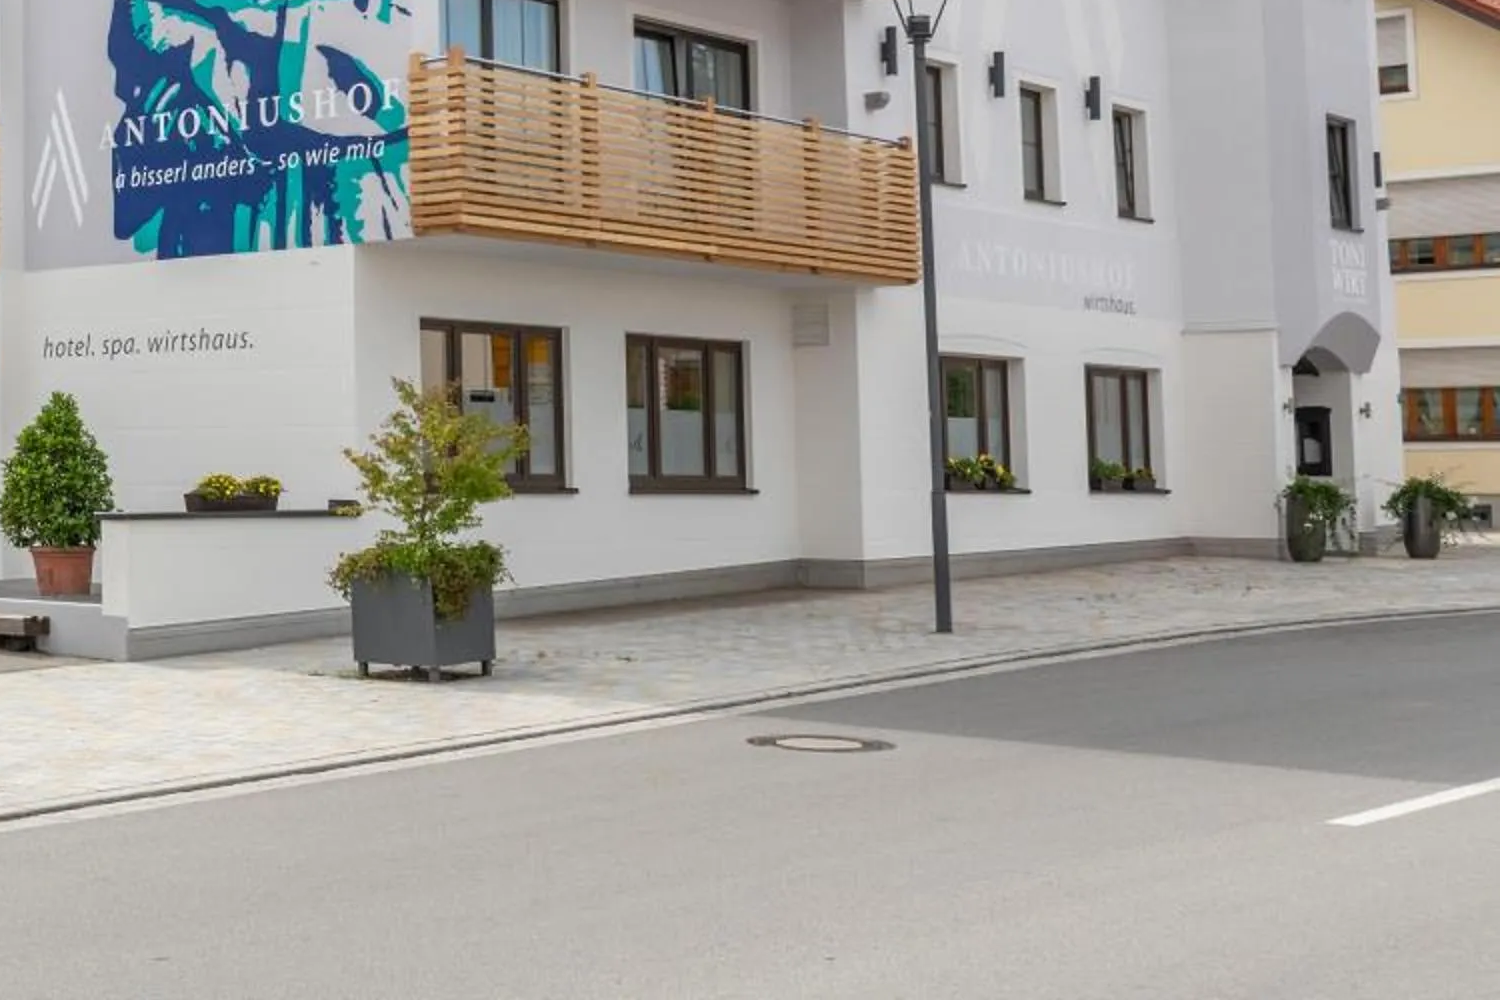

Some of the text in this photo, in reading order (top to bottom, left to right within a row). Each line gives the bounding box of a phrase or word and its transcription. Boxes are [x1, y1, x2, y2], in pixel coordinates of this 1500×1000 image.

[100, 78, 400, 149] ANTONIUSHOF
[130, 159, 188, 188] bisserl
[191, 155, 255, 182] anders
[277, 151, 300, 171] so
[305, 143, 340, 167] wie
[345, 137, 386, 161] mia
[42, 328, 254, 360] hotel. spa. wirtshaus.
